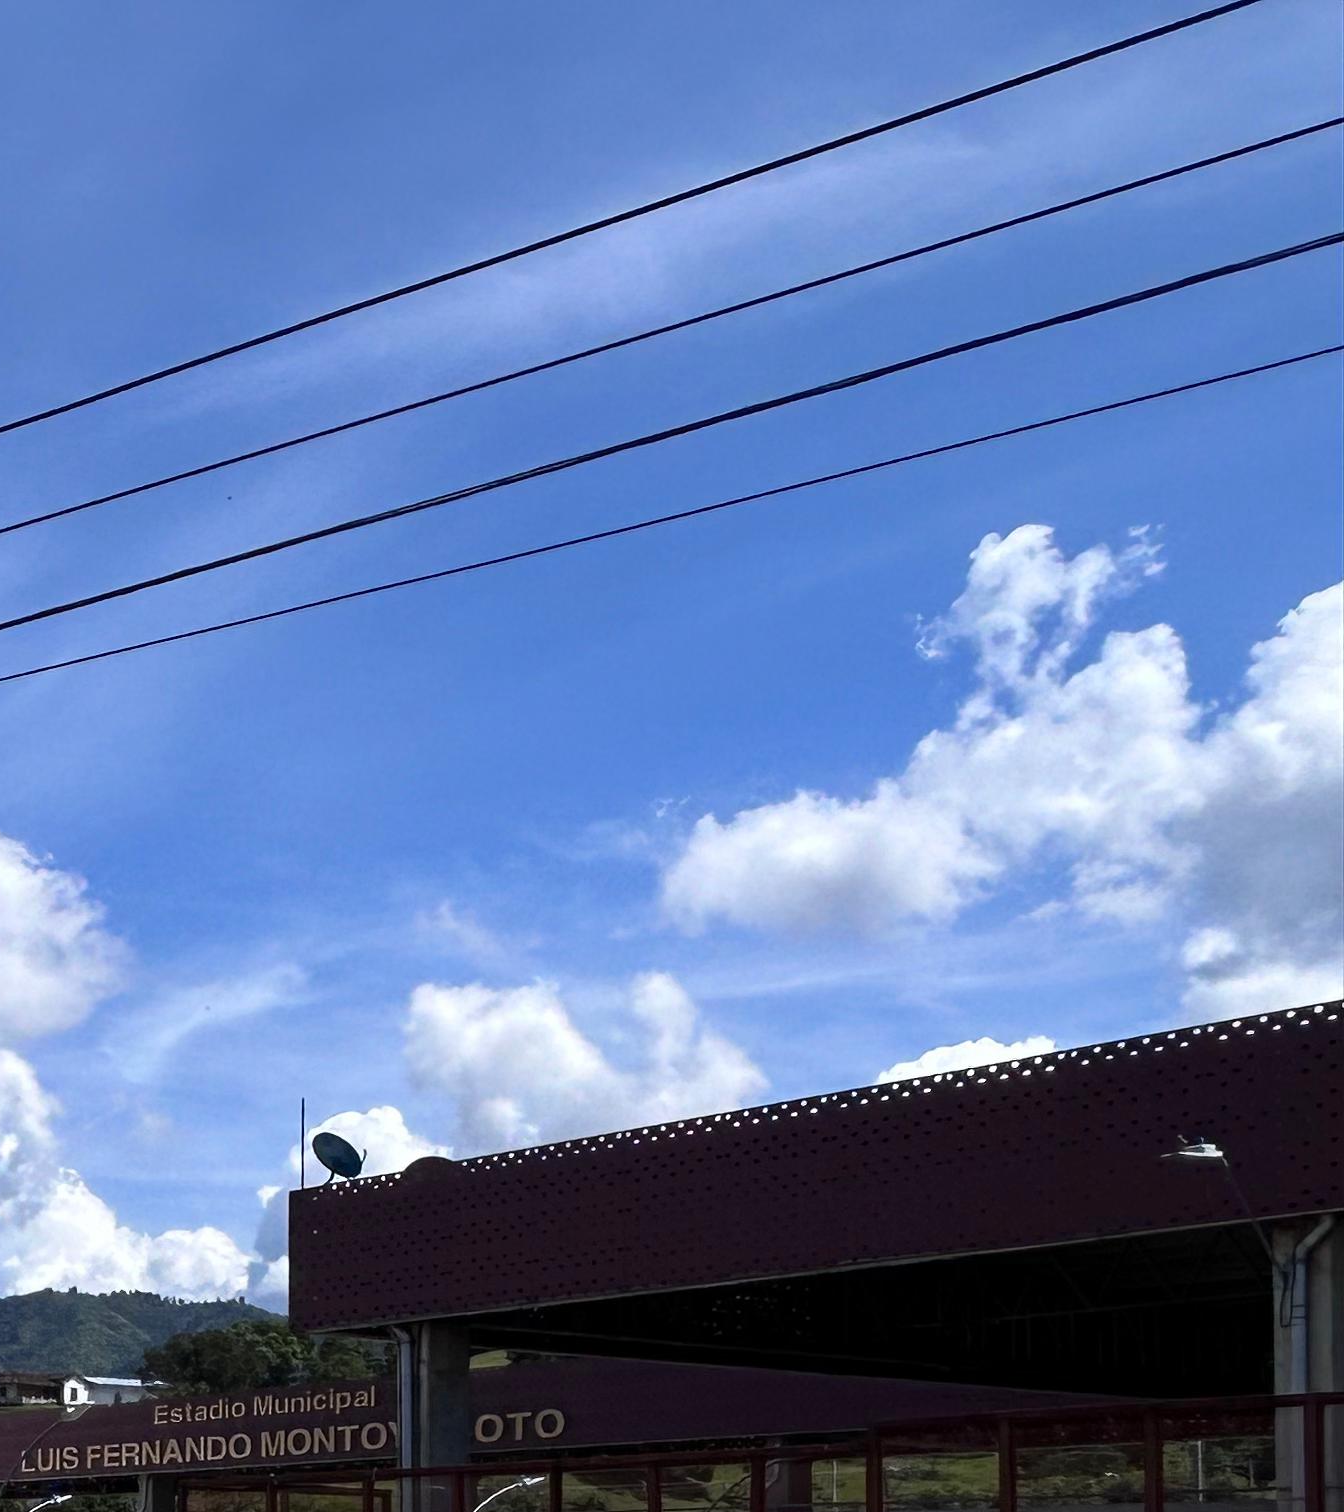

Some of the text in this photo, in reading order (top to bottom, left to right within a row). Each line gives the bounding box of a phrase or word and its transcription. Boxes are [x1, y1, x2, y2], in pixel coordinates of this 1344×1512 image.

[154, 1386, 376, 1425] Estadio Municipal
[21, 1447, 80, 1473] LUIS
[87, 1434, 252, 1470] FERNANDO
